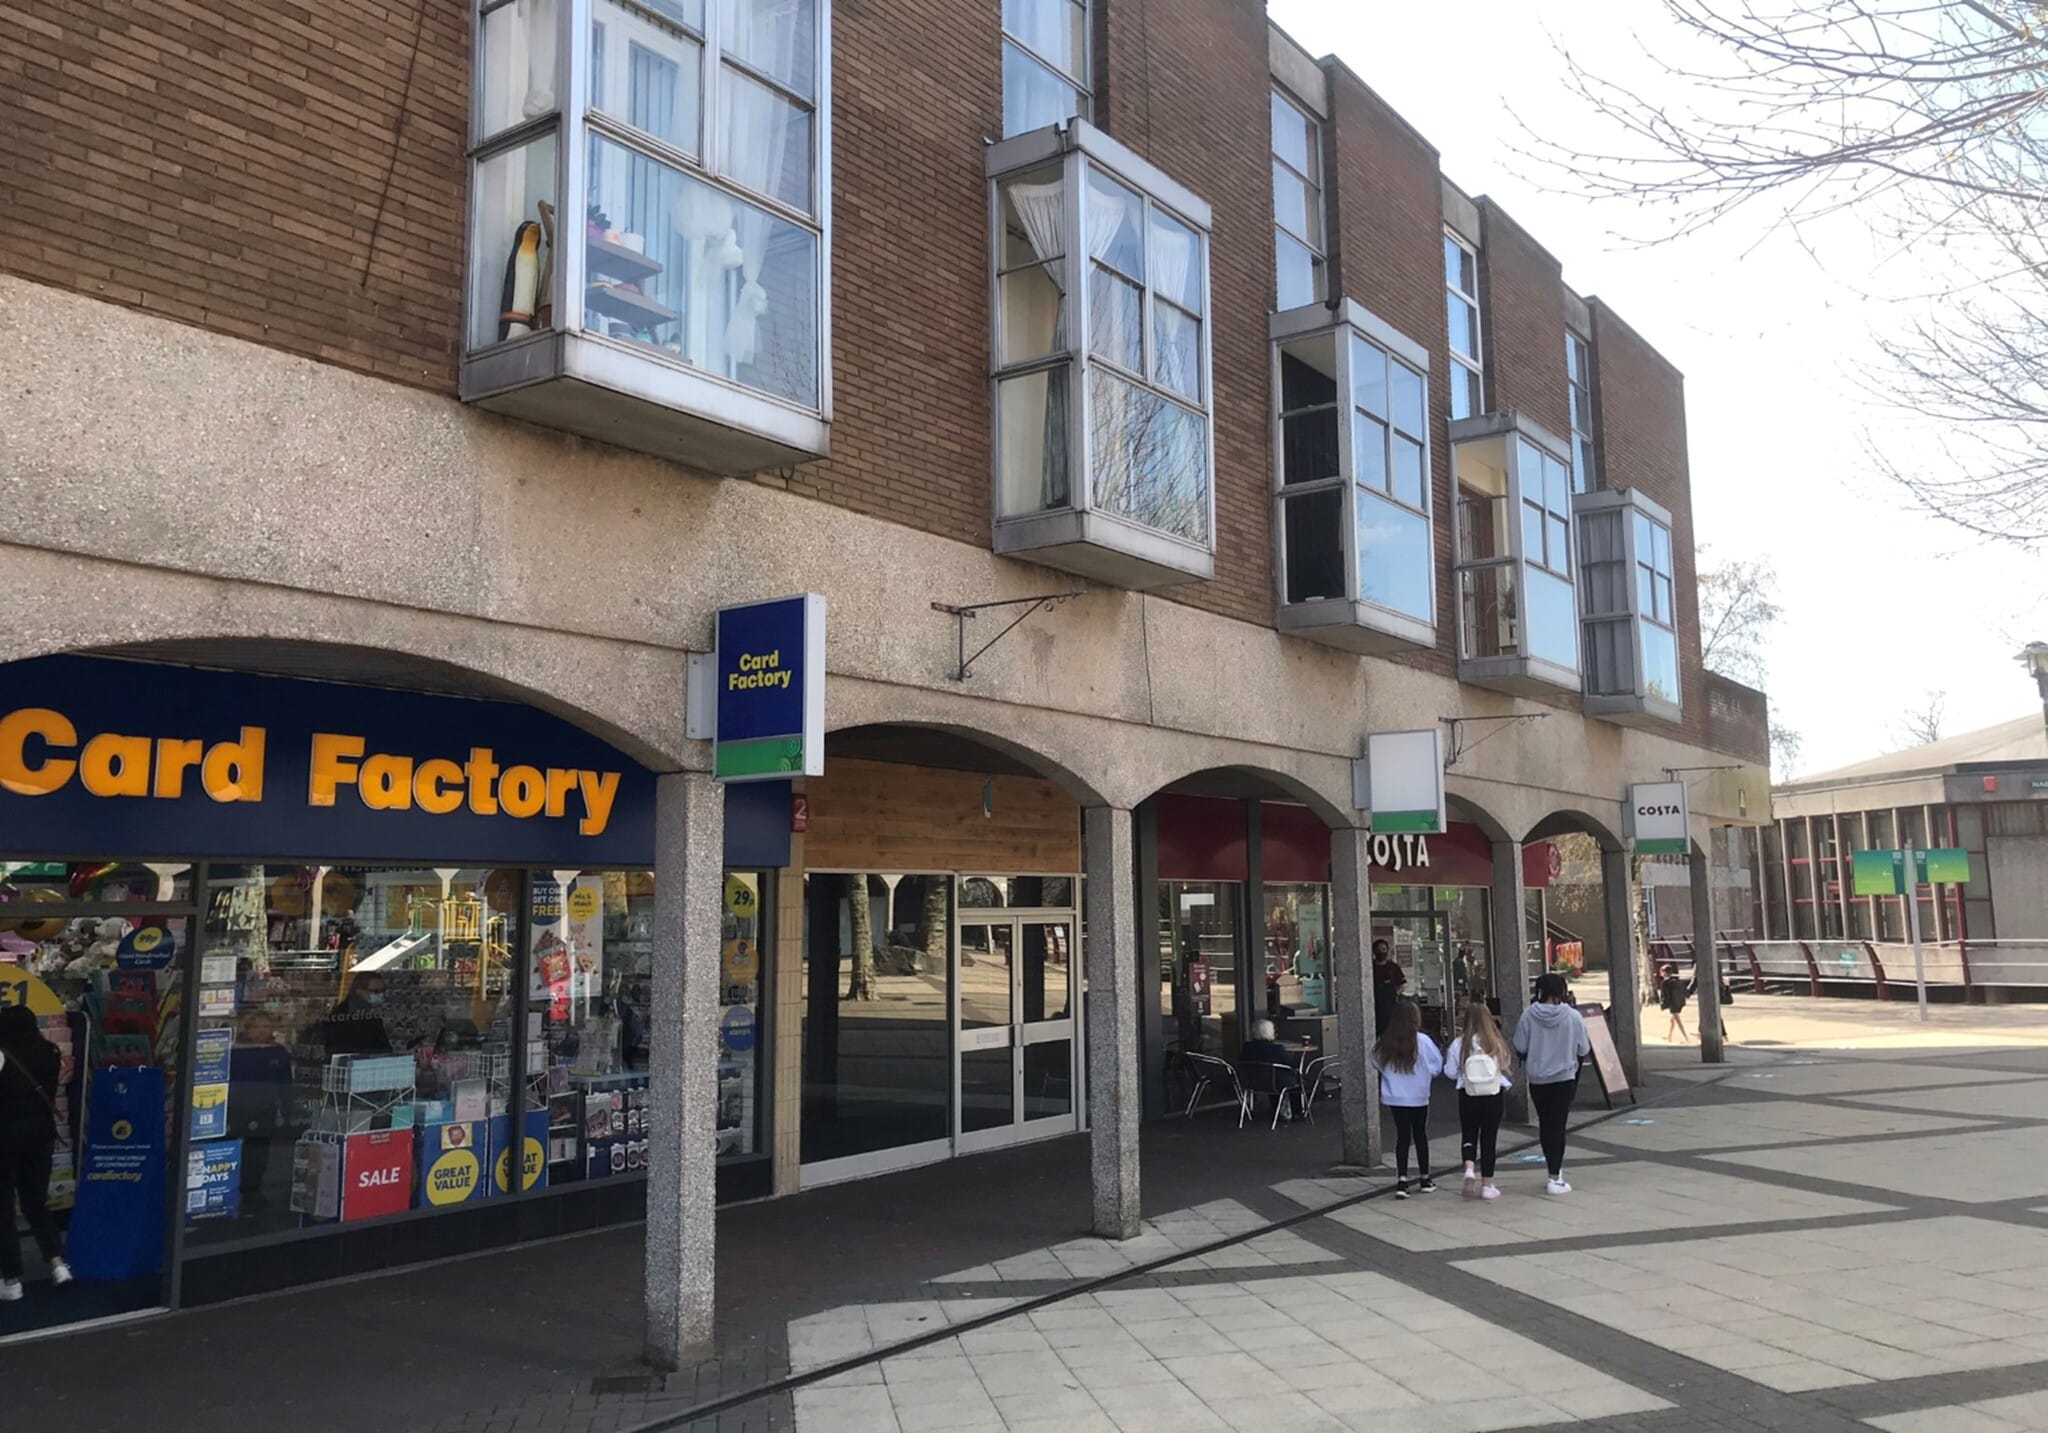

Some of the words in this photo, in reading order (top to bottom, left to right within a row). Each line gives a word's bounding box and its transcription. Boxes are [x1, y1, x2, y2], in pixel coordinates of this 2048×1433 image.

[738, 649, 780, 672] Card
[728, 669, 792, 691] Factory
[0, 708, 267, 803] Card
[308, 732, 622, 836] Factory
[1637, 804, 1681, 816] COSTA
[1367, 832, 1430, 872] OSTA
[532, 887, 548, 895] BUY
[548, 887, 561, 895] ON
[532, 895, 548, 904] GET
[548, 895, 561, 904] ON
[532, 904, 561, 917] FREE
[202, 1161, 238, 1174] HAPPY
[503, 1152, 537, 1168] GAT
[202, 1172, 230, 1184] DAYS
[358, 1166, 401, 1188] SALE
[434, 1164, 472, 1180] GREAT
[503, 1163, 537, 1179] VUE
[434, 1176, 471, 1191] VALUE
